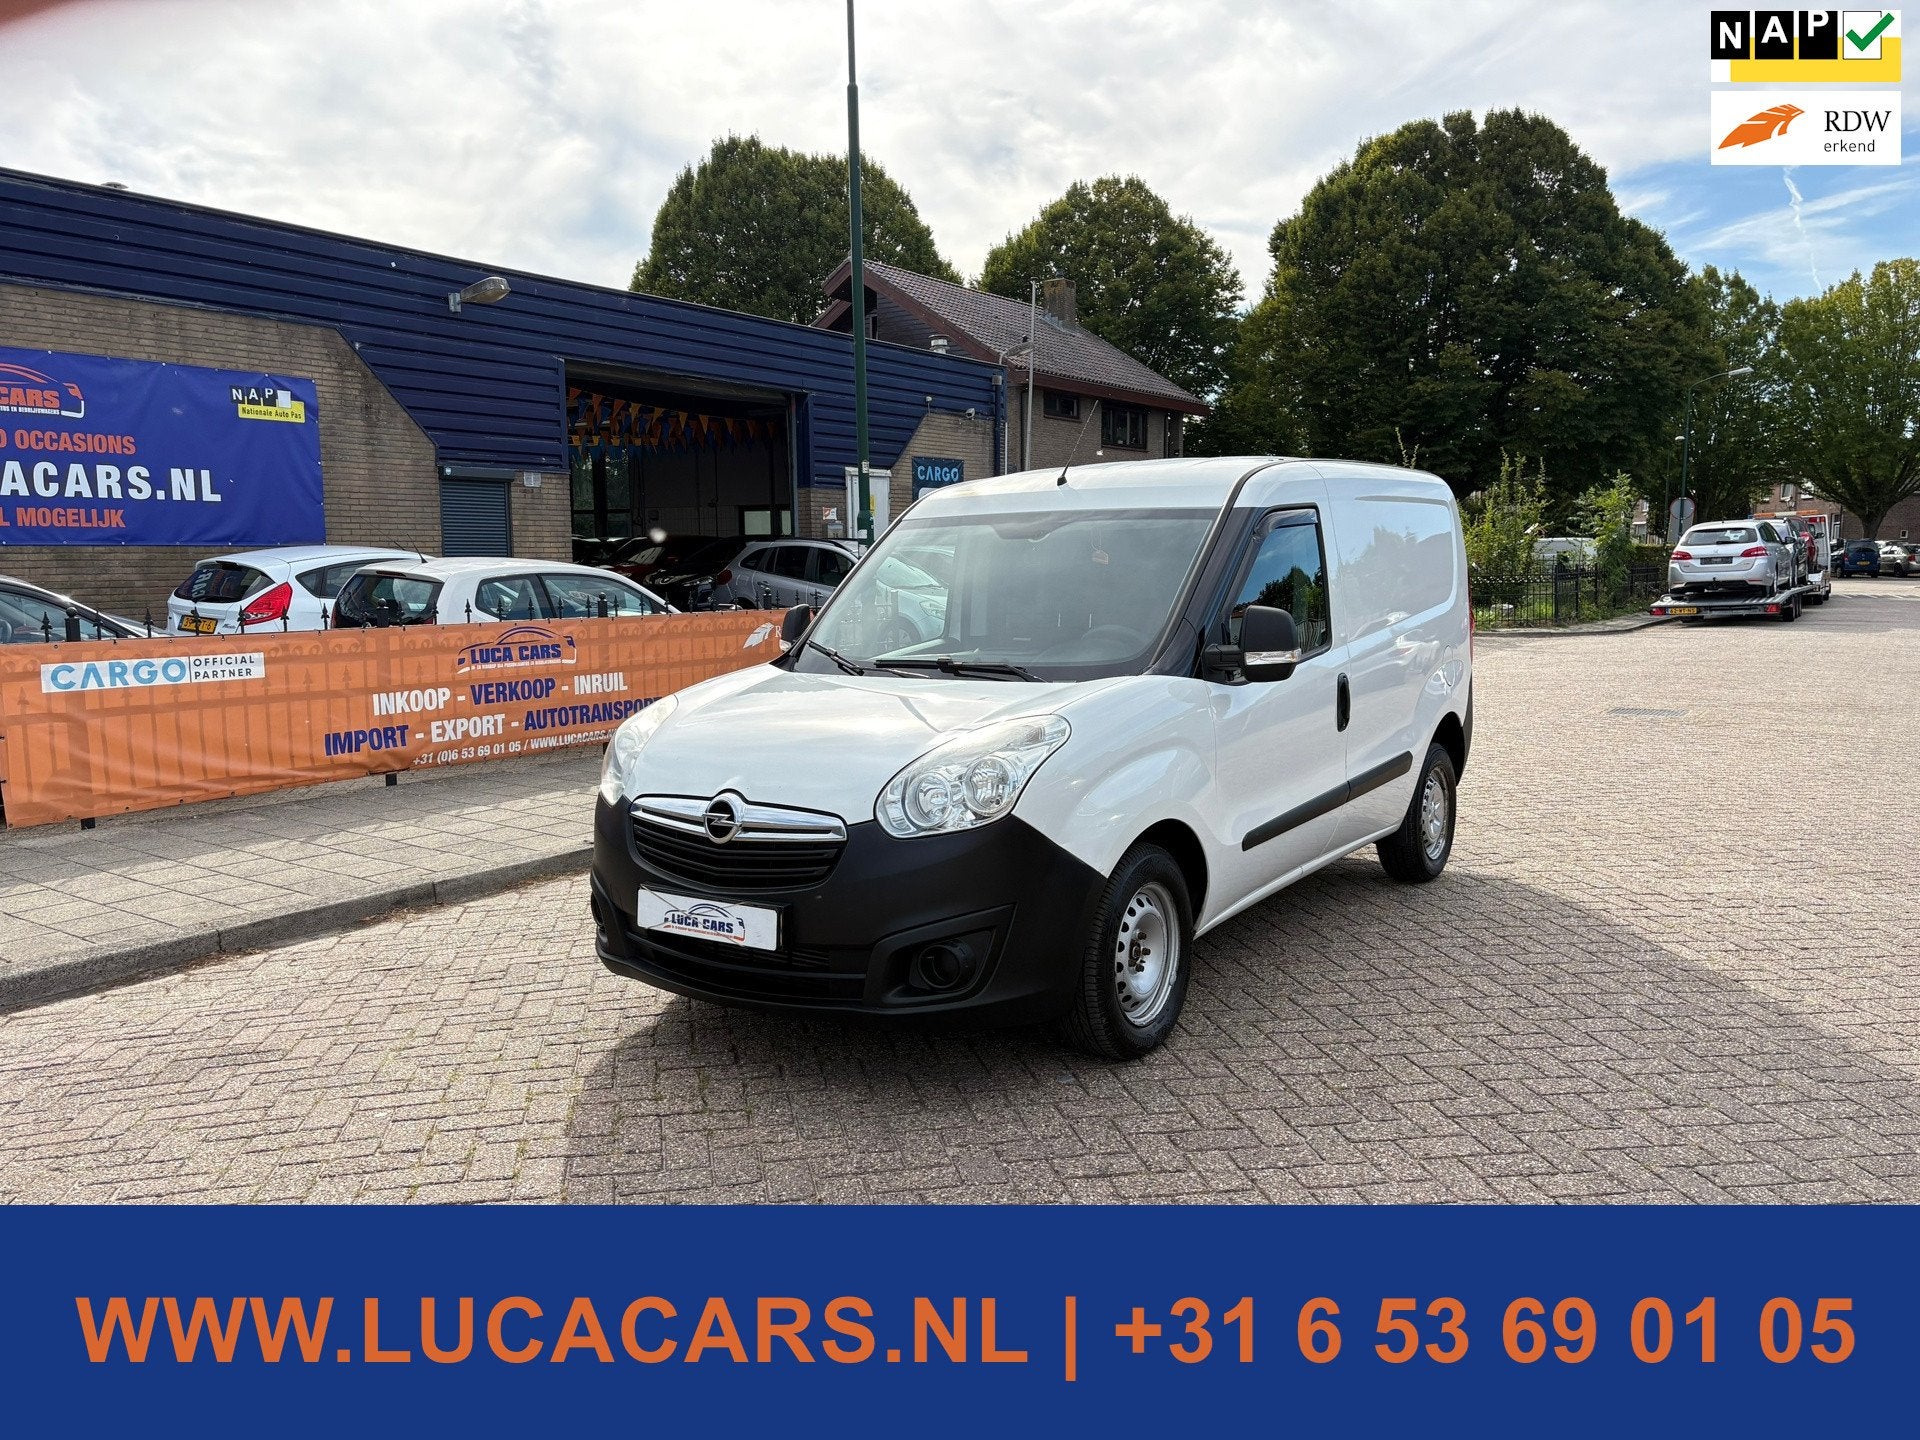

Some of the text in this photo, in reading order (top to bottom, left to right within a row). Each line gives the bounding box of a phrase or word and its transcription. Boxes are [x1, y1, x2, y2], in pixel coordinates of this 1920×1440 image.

[231, 387, 274, 401] NAP
[241, 406, 302, 420] Nationale Auto Pas
[14, 429, 137, 455] OCCASIONS
[0, 460, 222, 502] ACARS.NL
[917, 465, 959, 482] CARGO
[16, 507, 125, 528] MOGELIJK
[193, 655, 255, 667] OFFICIAL
[470, 643, 562, 664] LUCA CARS
[50, 658, 187, 690] CARGO
[194, 668, 252, 680] PARTNER
[373, 687, 450, 716] INKOOP
[470, 677, 556, 706] VERKOOP
[574, 671, 628, 695] INRUIL
[324, 725, 409, 756] IMPORT
[430, 713, 506, 743] EXPORT
[524, 697, 662, 731] AUTOTRANSPO
[413, 752, 433, 765] +31
[437, 748, 458, 764] (0)6
[462, 746, 474, 759] 53
[477, 744, 490, 757] 69
[493, 742, 504, 755] 01
[508, 740, 521, 752] 05
[530, 728, 618, 749] WWW.LUCACARS.N
[671, 913, 699, 928] LUCA
[702, 918, 734, 934] CARS
